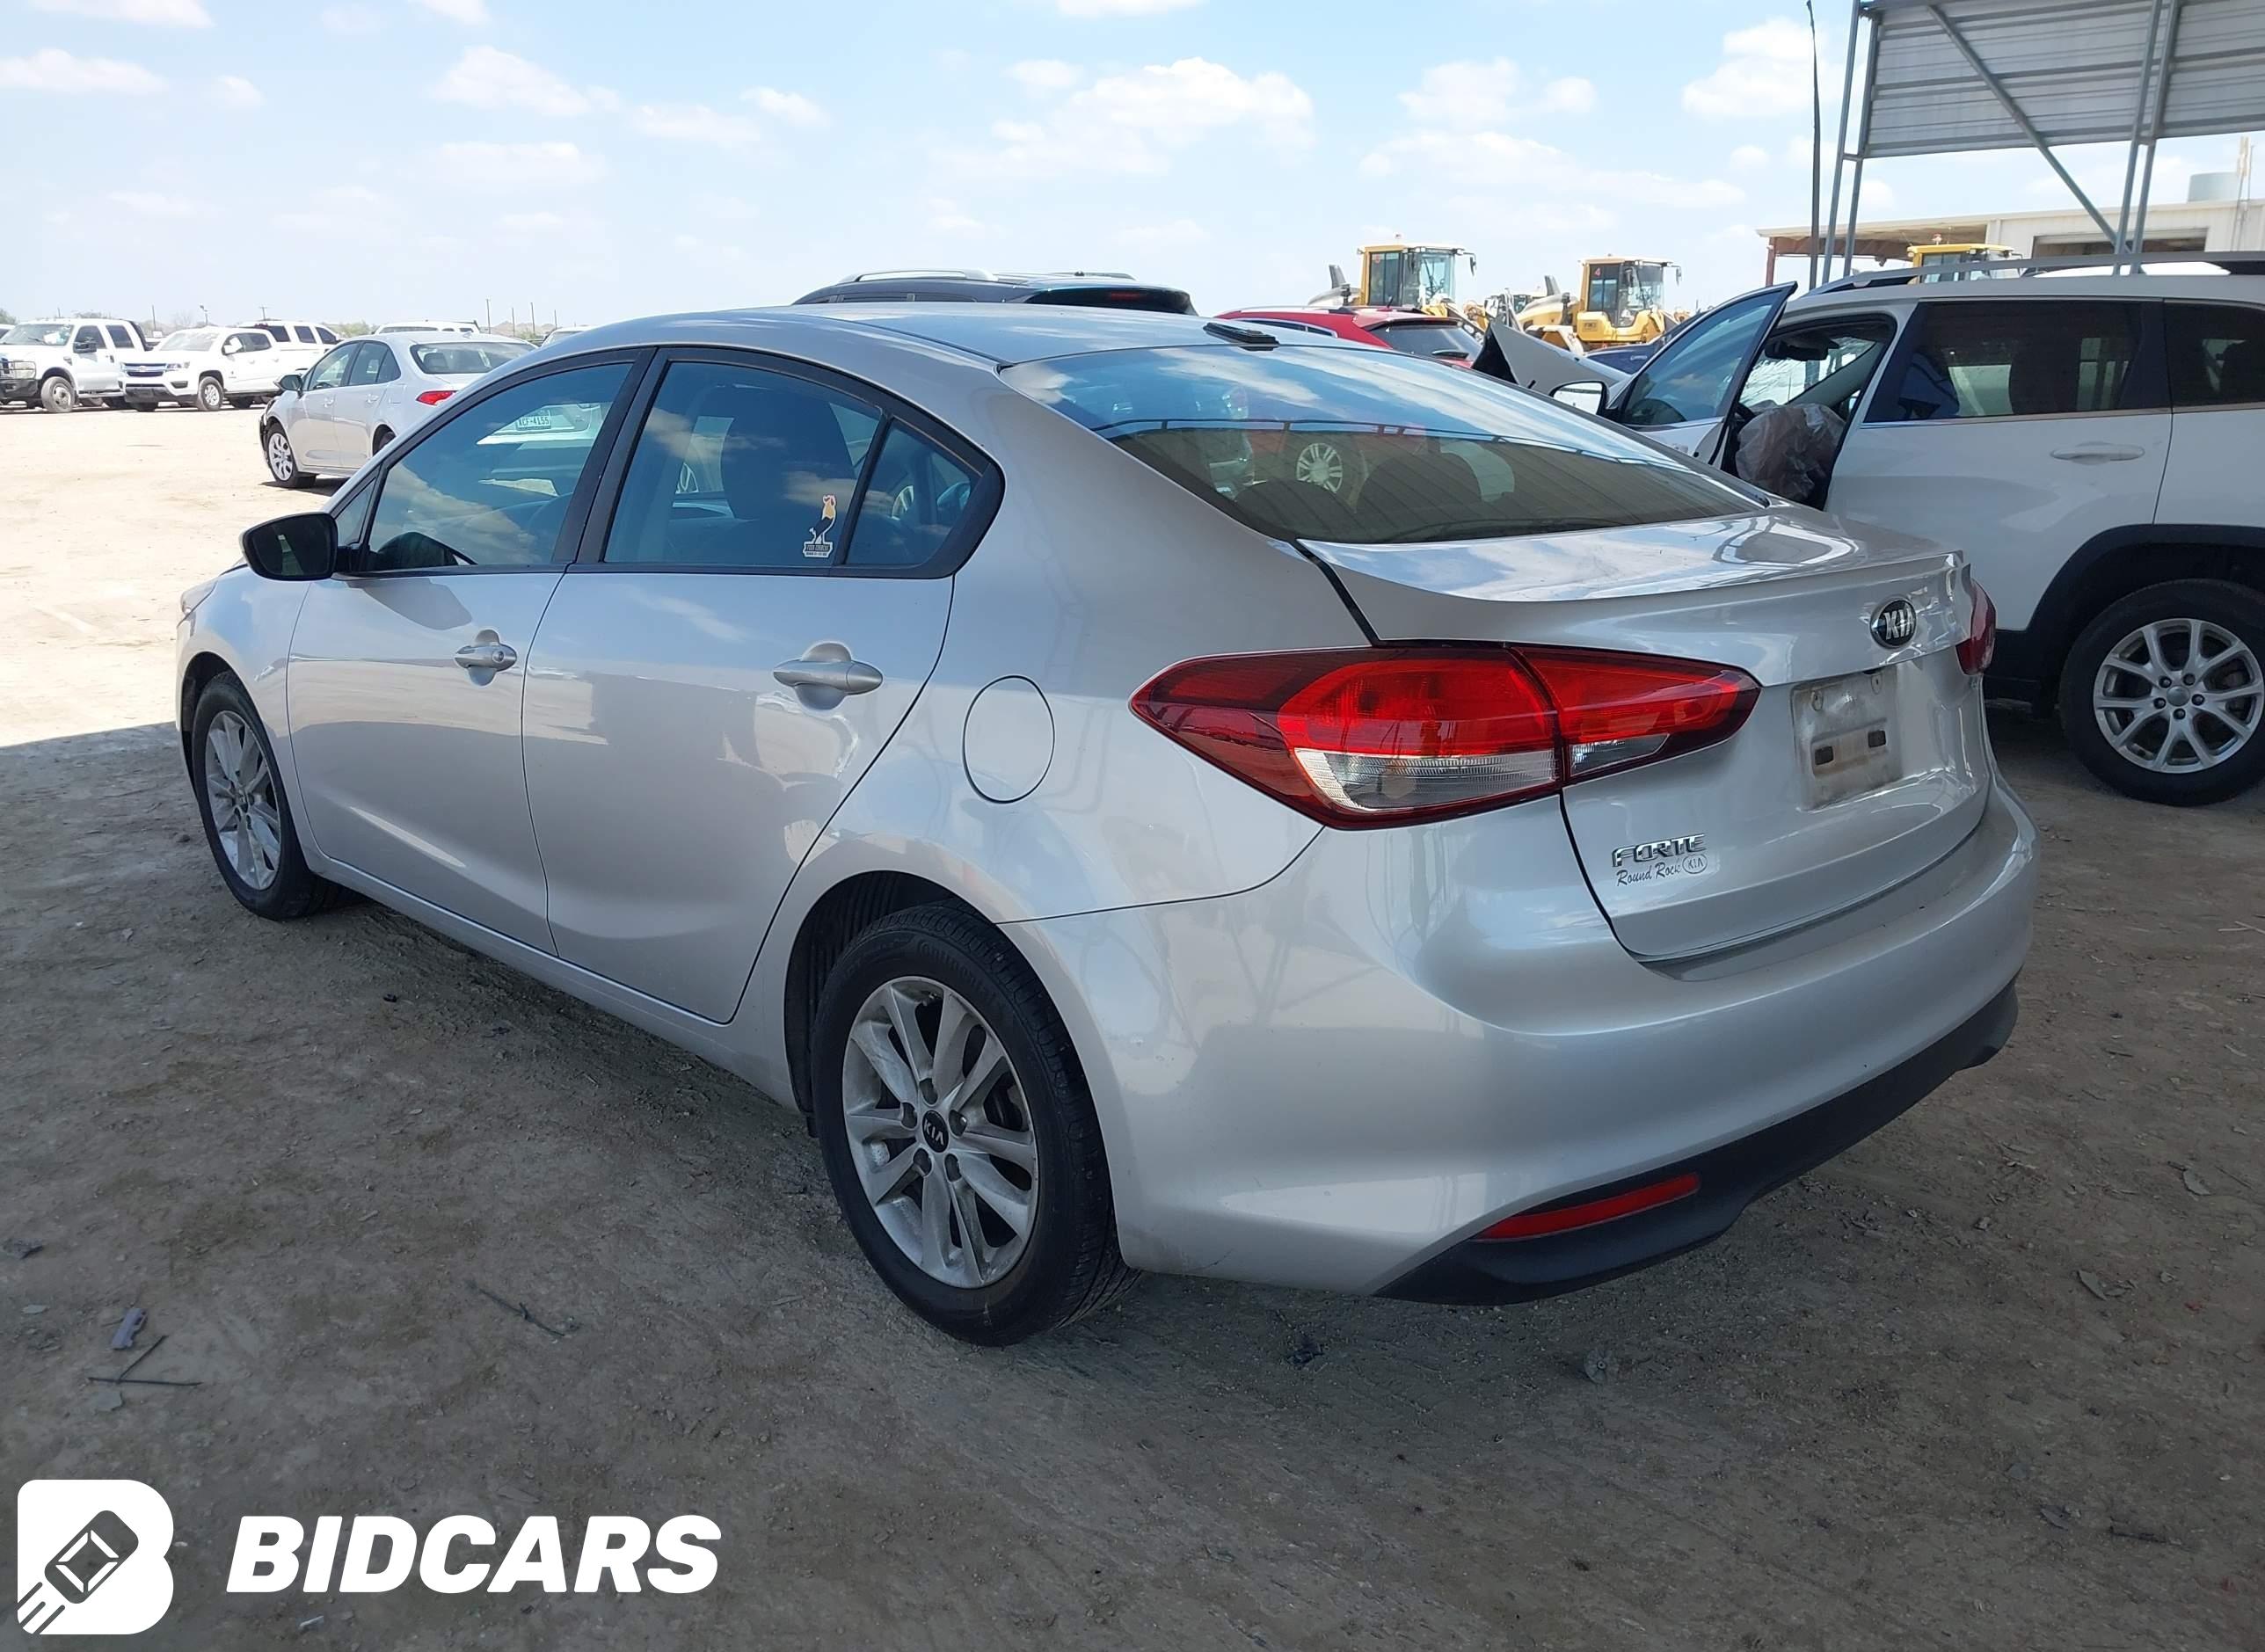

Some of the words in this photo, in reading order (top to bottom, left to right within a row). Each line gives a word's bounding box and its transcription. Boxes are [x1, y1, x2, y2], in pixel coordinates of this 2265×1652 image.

[1883, 608, 1915, 640] KIA
[1612, 833, 1708, 868] FORTE
[1616, 864, 1653, 886] Round
[923, 1117, 944, 1146] KIA
